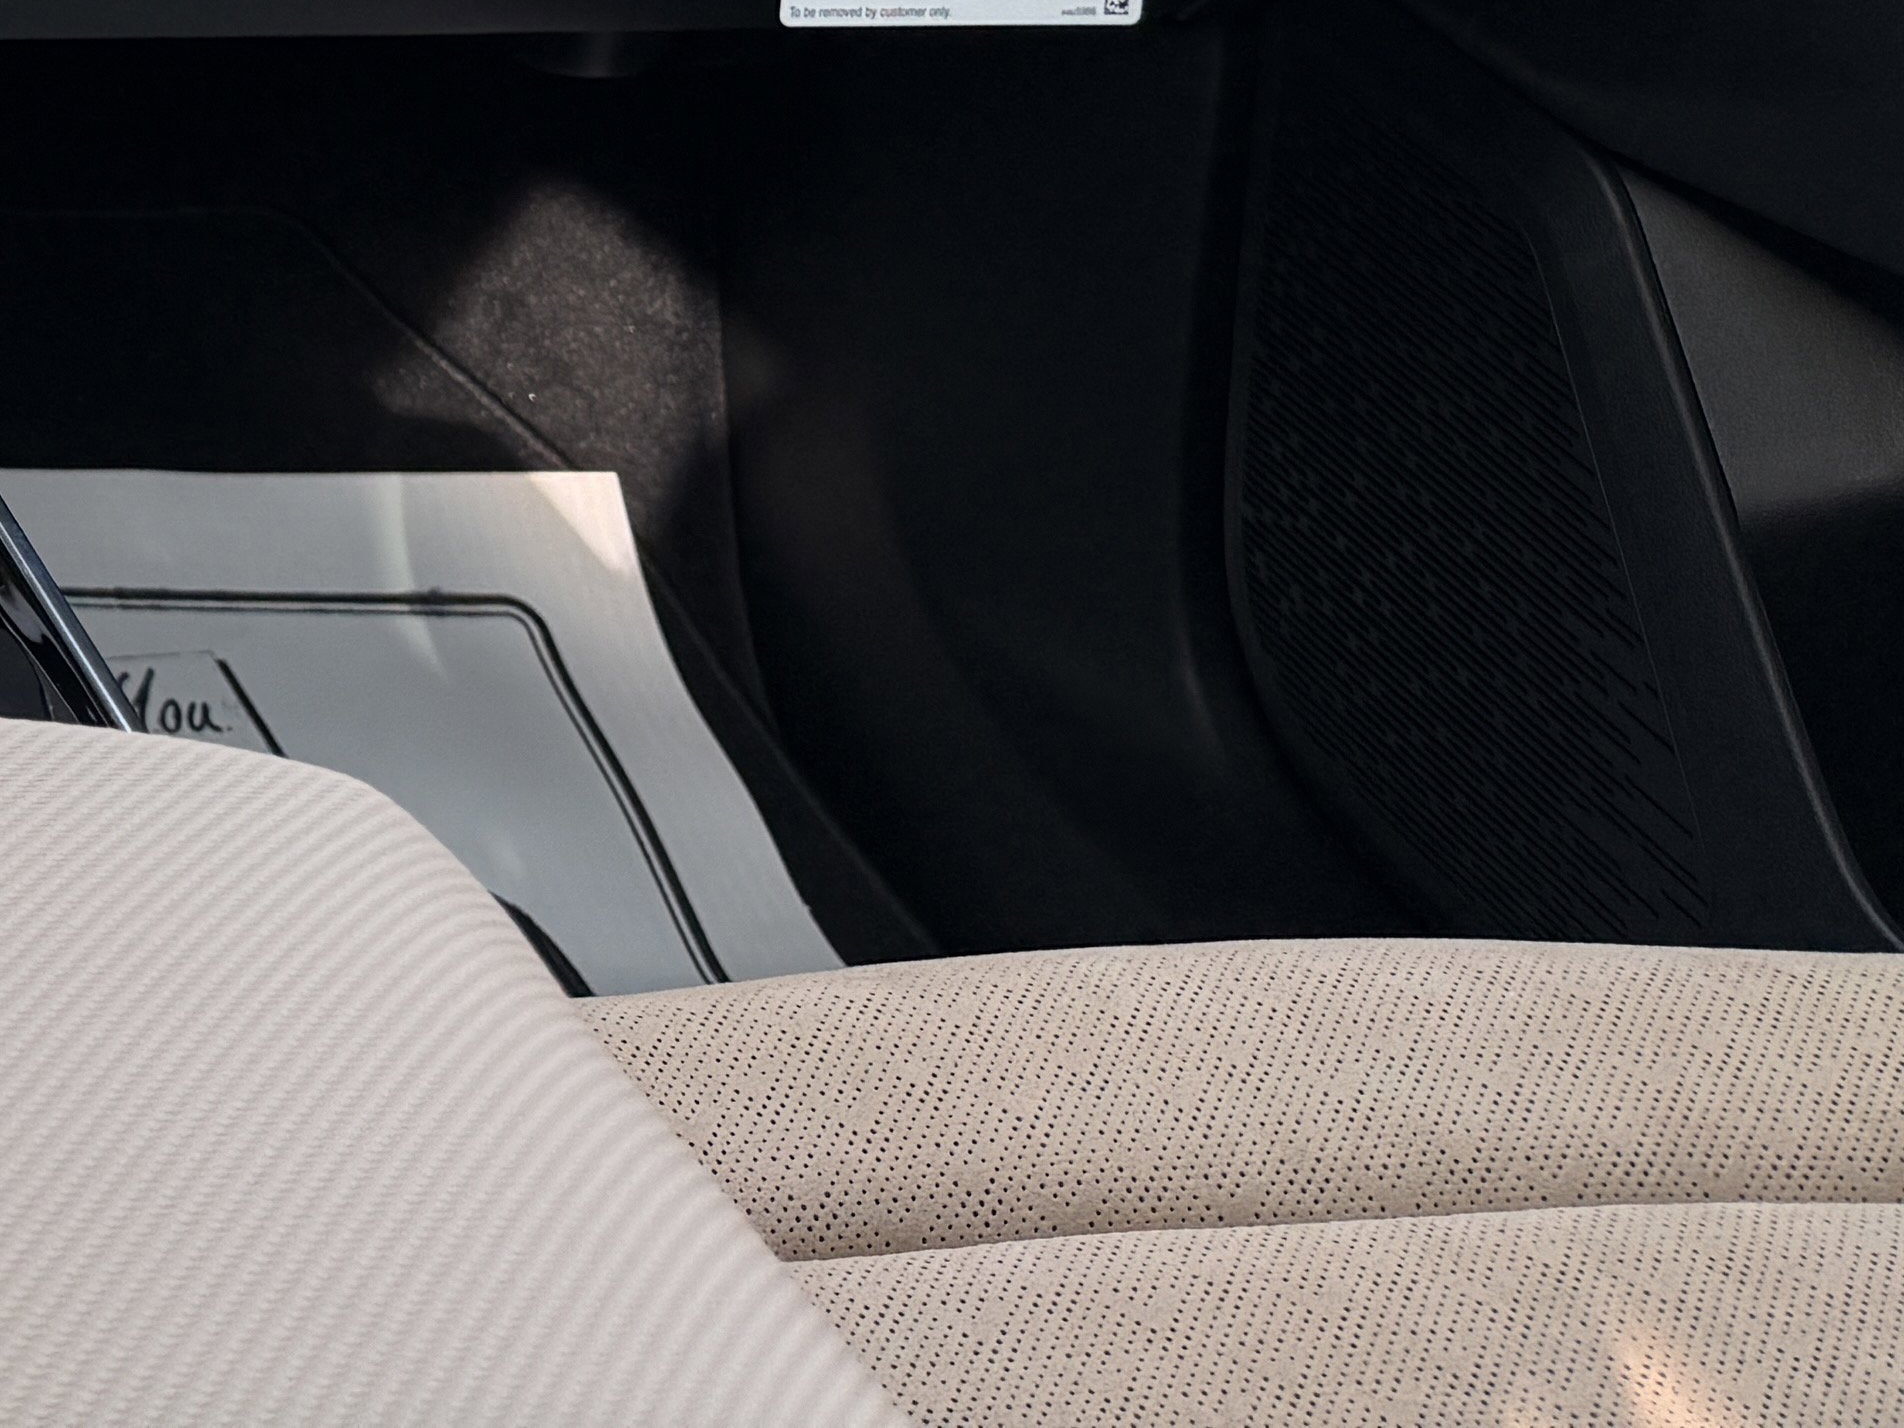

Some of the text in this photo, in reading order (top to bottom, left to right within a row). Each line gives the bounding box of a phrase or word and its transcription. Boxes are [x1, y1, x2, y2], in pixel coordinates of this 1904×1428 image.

[790, 5, 801, 18] To
[803, 5, 816, 18] be
[818, 5, 863, 18] removed
[865, 6, 878, 20] by
[879, 5, 927, 18] customer
